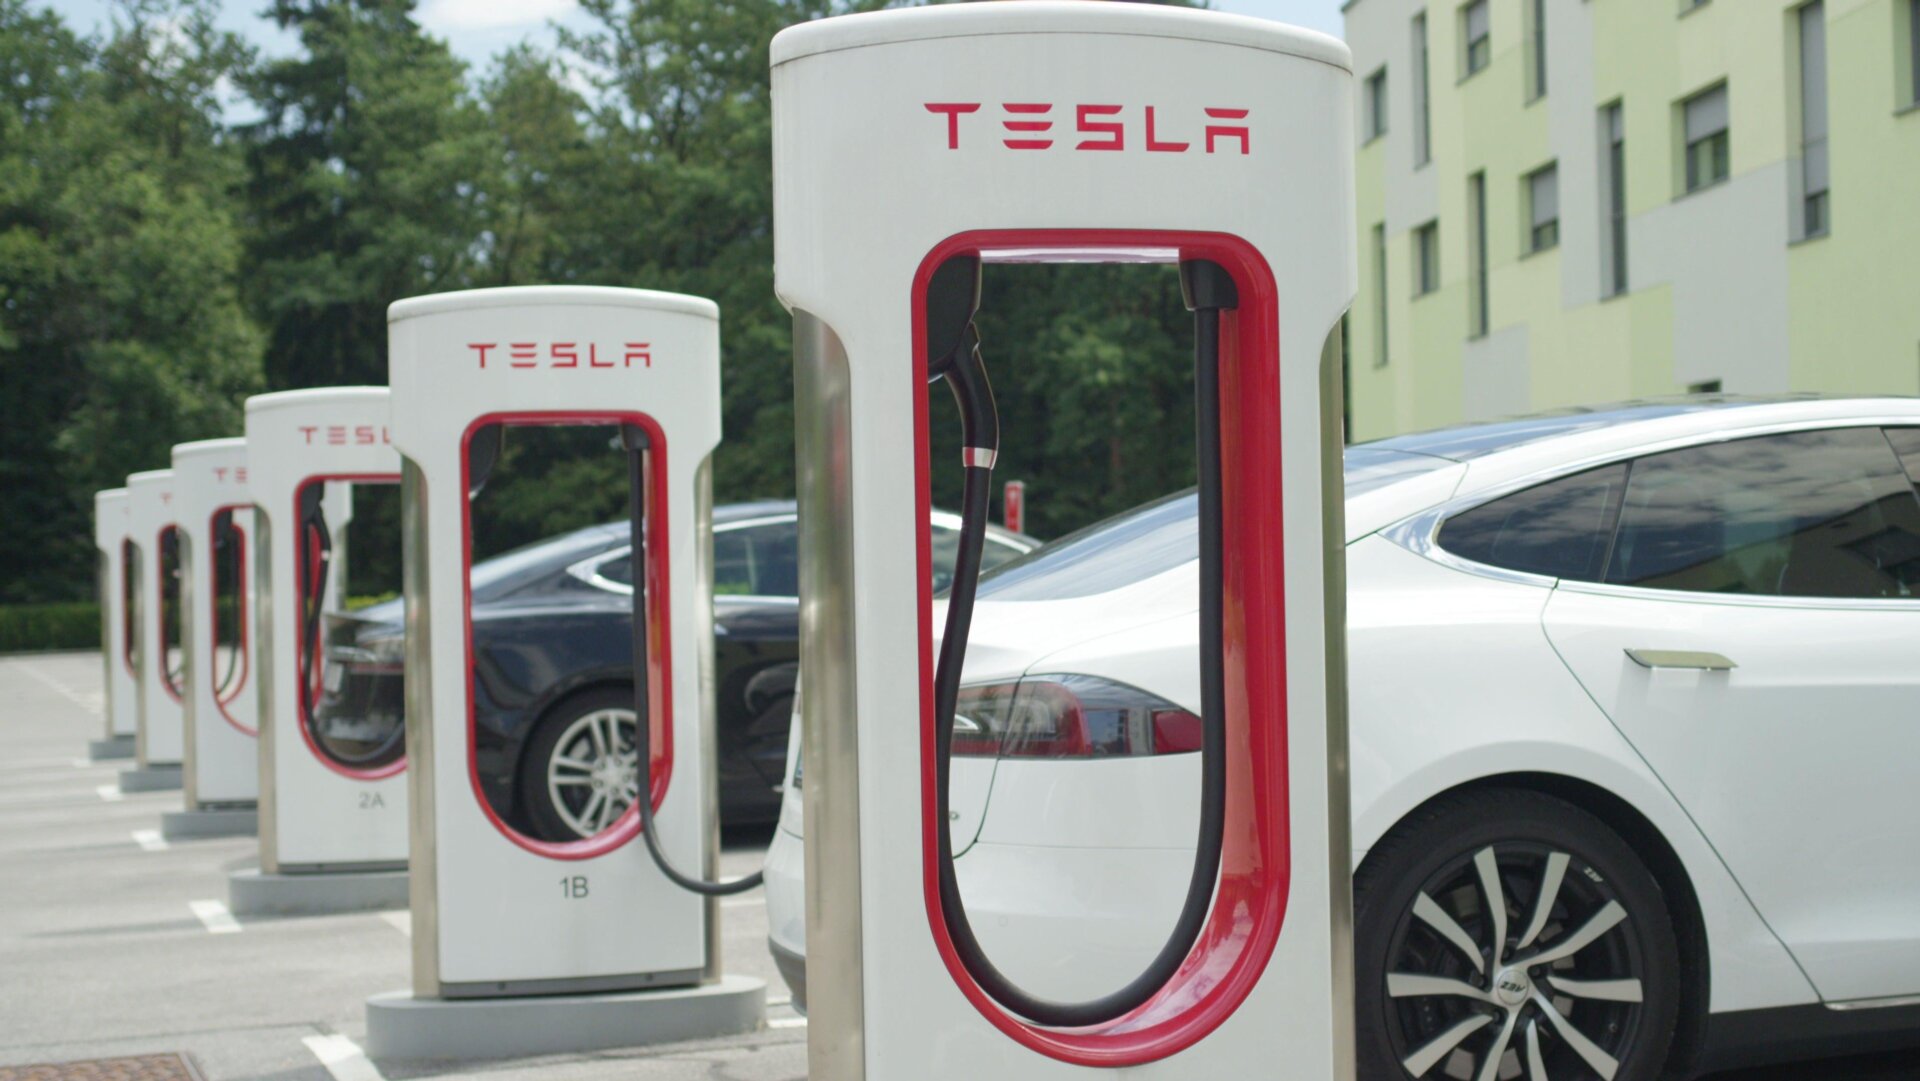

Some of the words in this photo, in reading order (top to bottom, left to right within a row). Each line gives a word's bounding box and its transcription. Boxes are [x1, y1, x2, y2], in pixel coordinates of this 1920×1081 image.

[924, 102, 1250, 156] TESLA
[467, 342, 652, 369] TESLA
[358, 791, 385, 809] 2A
[560, 876, 589, 898] 1B
[1500, 981, 1526, 993] AEZ
